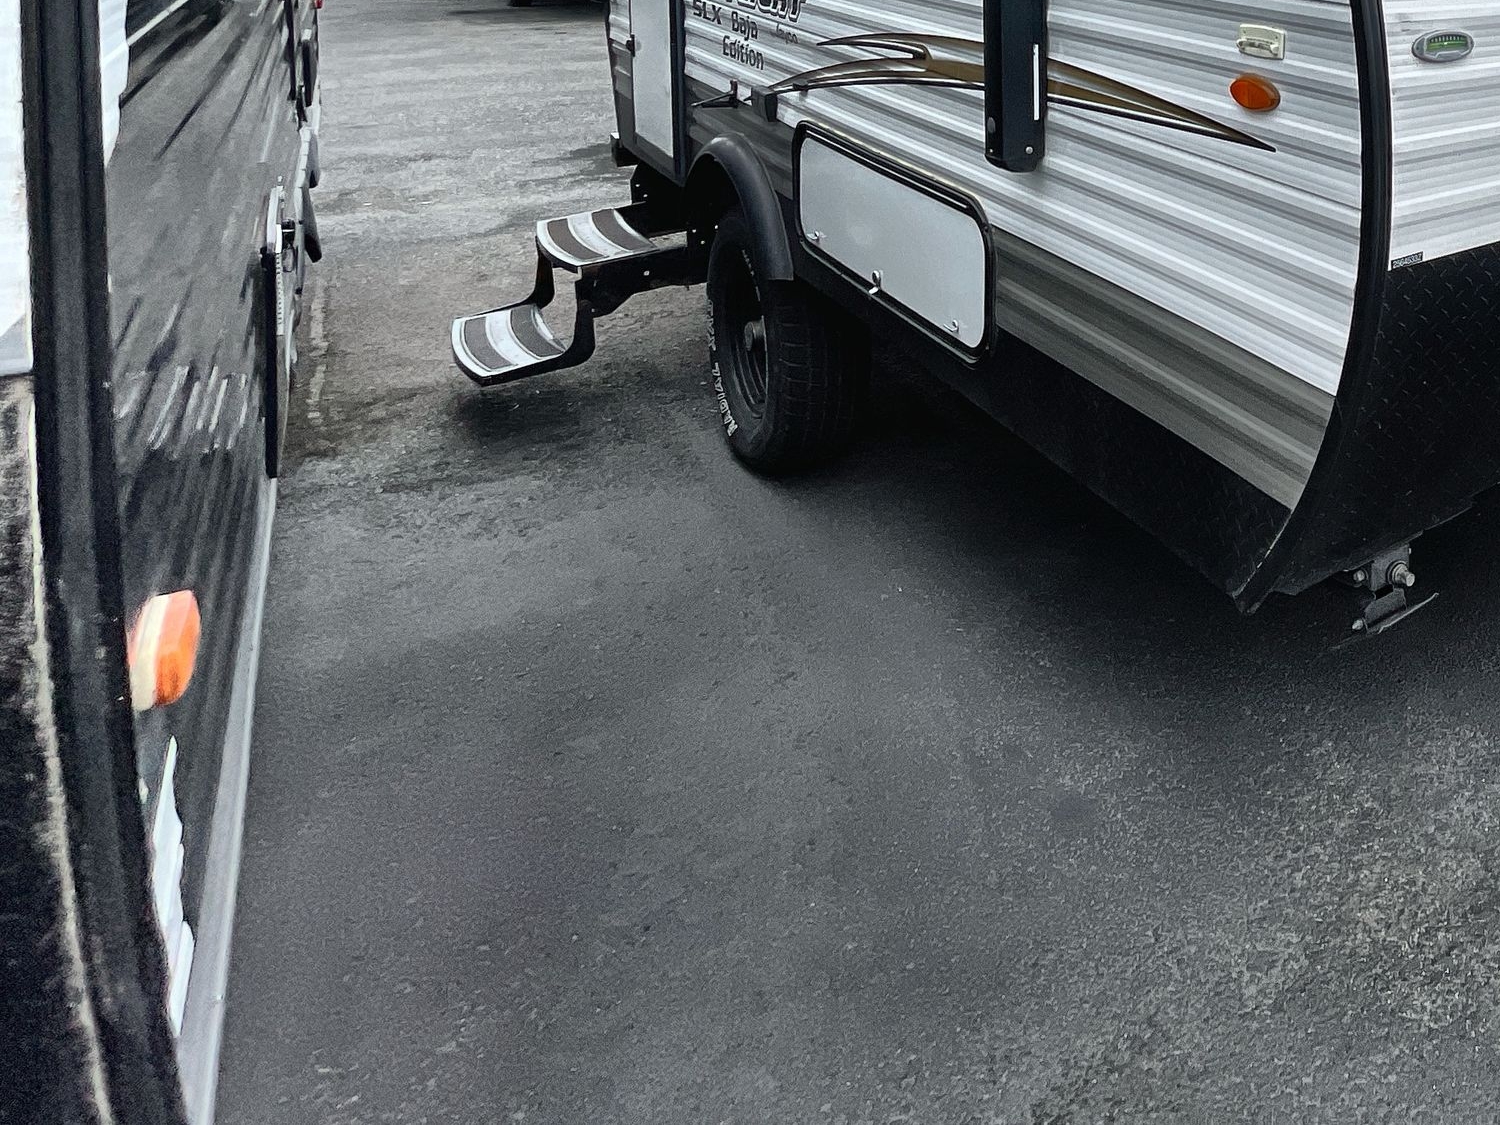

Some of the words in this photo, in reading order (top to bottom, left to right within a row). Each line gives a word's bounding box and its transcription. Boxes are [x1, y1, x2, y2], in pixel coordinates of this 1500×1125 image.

[731, 11, 758, 41] Baja
[722, 35, 764, 70] Edition
[712, 362, 738, 436] RADIAL
